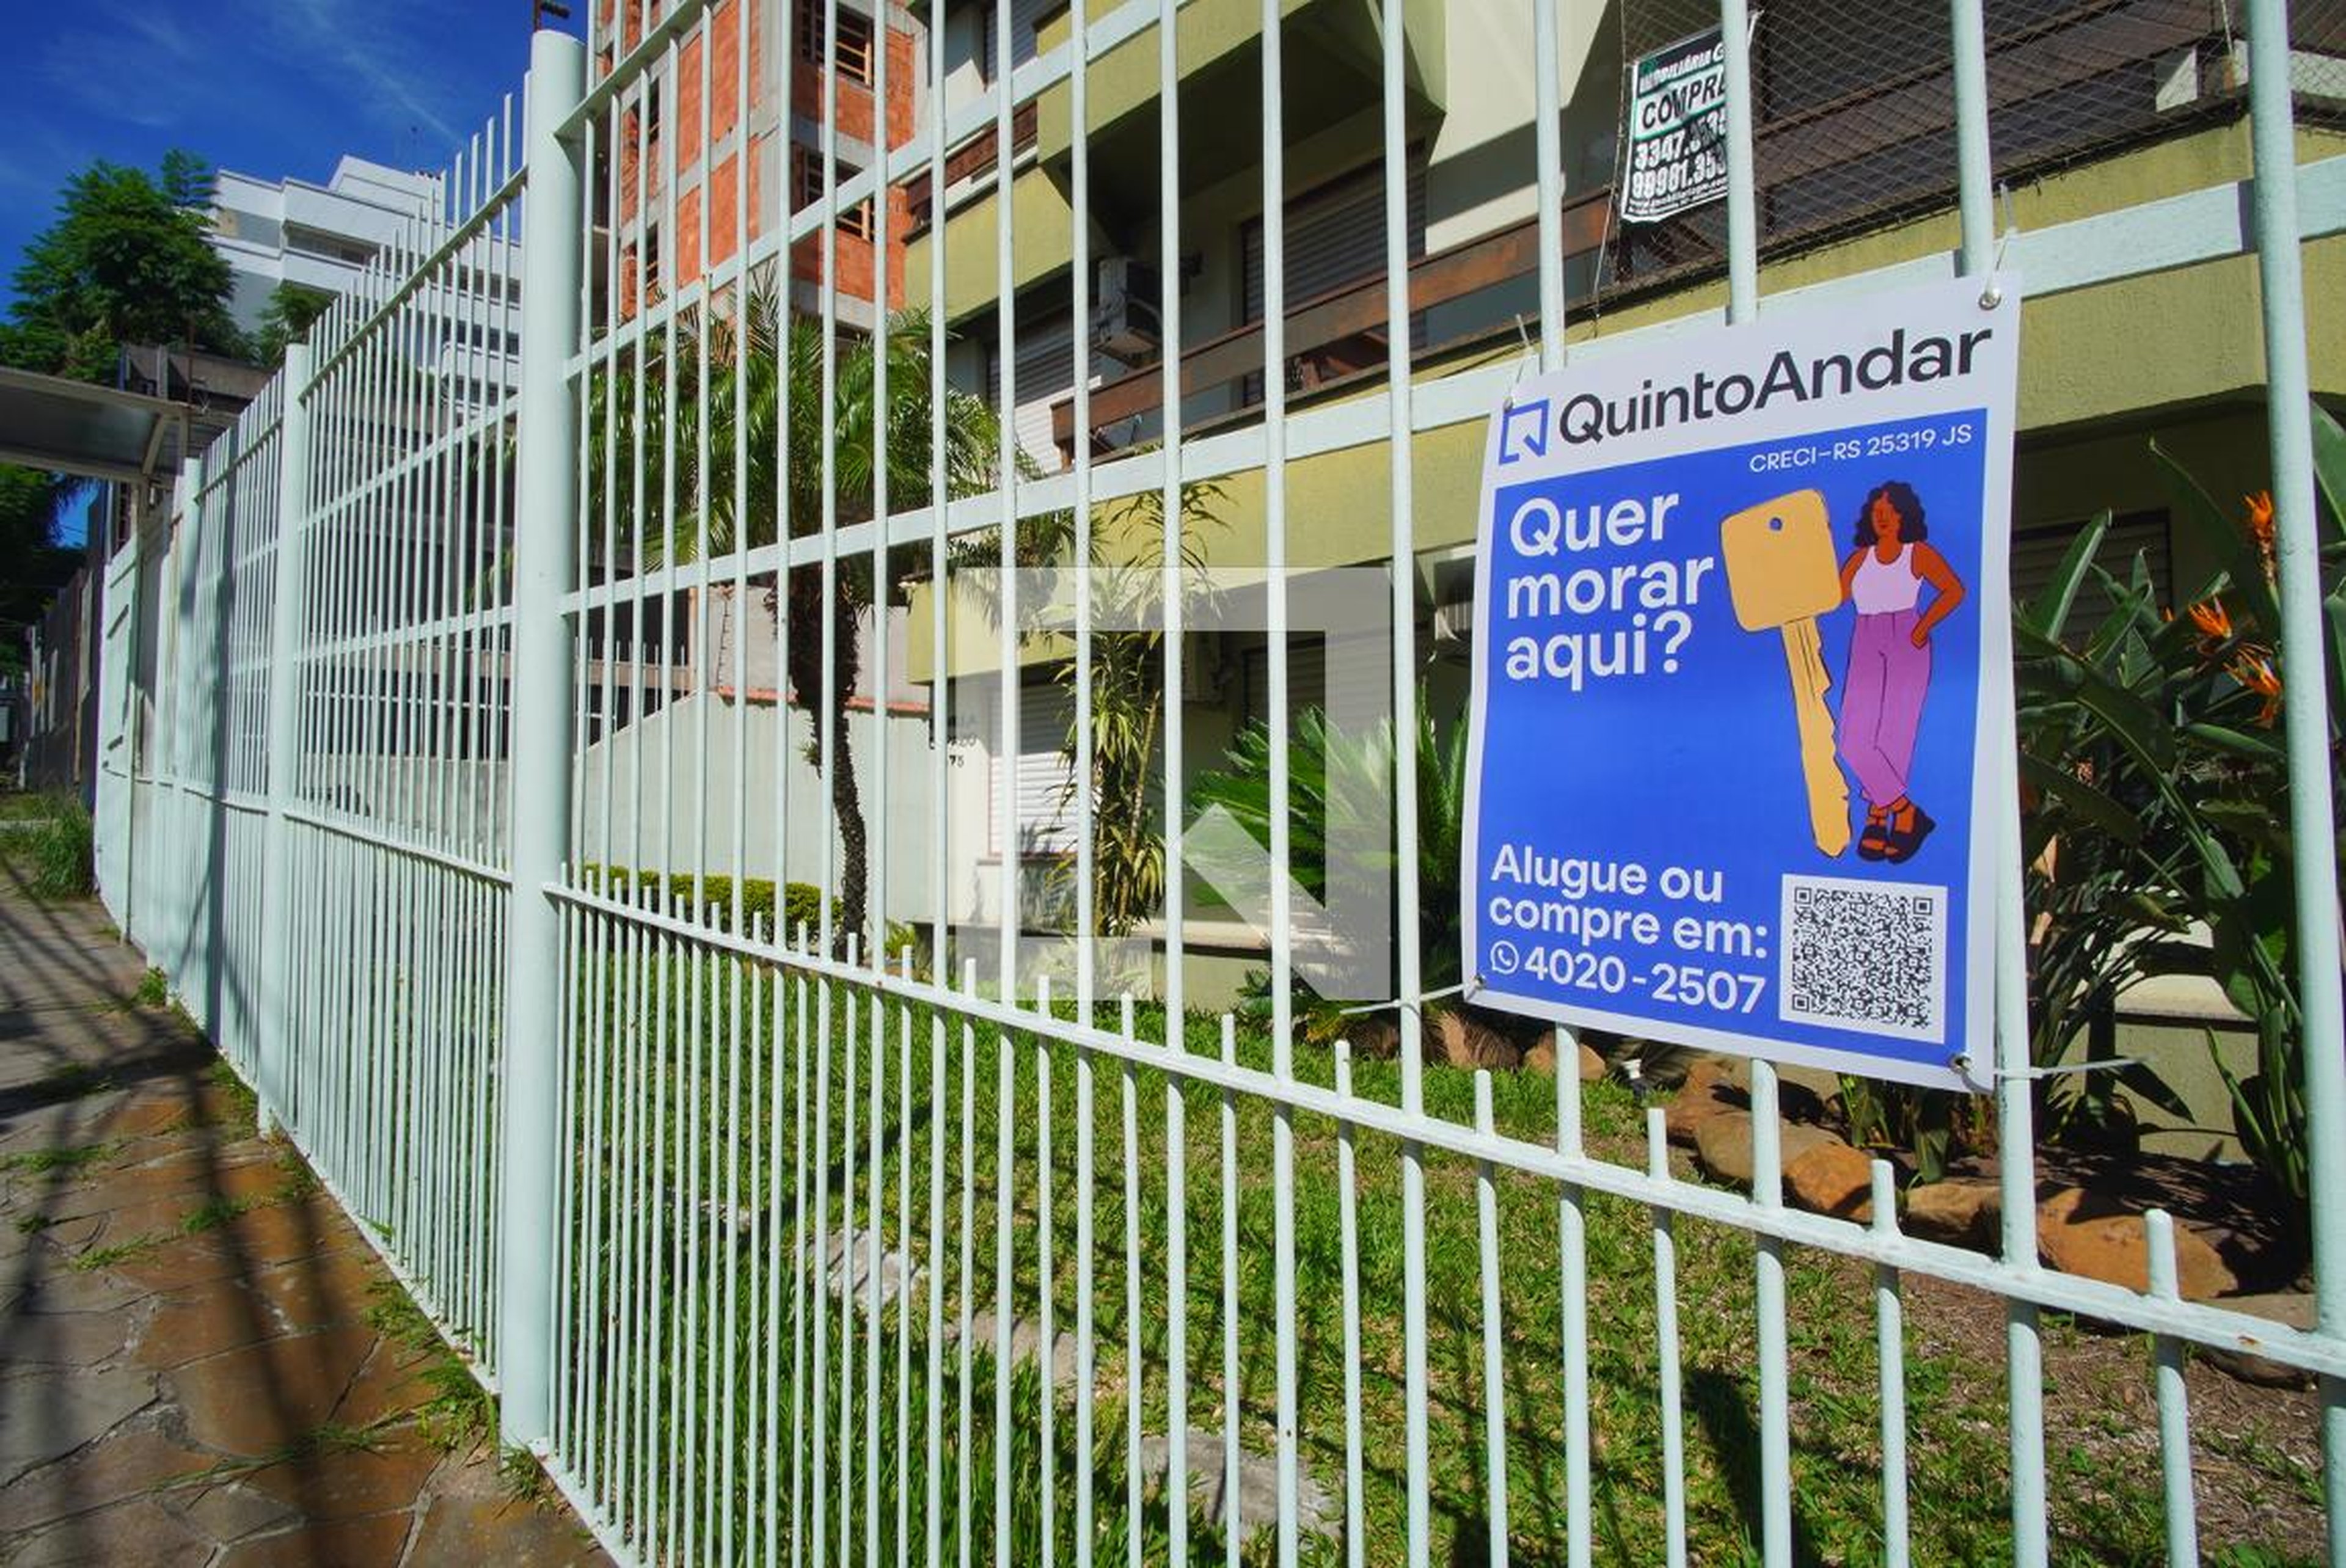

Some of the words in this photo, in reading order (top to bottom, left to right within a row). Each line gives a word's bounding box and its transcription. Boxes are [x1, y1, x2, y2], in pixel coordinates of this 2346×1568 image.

[1558, 327, 1993, 445] QuintoAndar
[1867, 429, 1936, 456] 25319
[1942, 424, 1972, 445] JS
[1510, 493, 1679, 557] Quer
[1507, 556, 1714, 619] morar
[1505, 610, 1693, 692] aqui?
[1489, 844, 1648, 900] Alugue
[1659, 866, 1723, 903] ou
[1489, 896, 1661, 947] compre
[1672, 917, 1767, 960] em:
